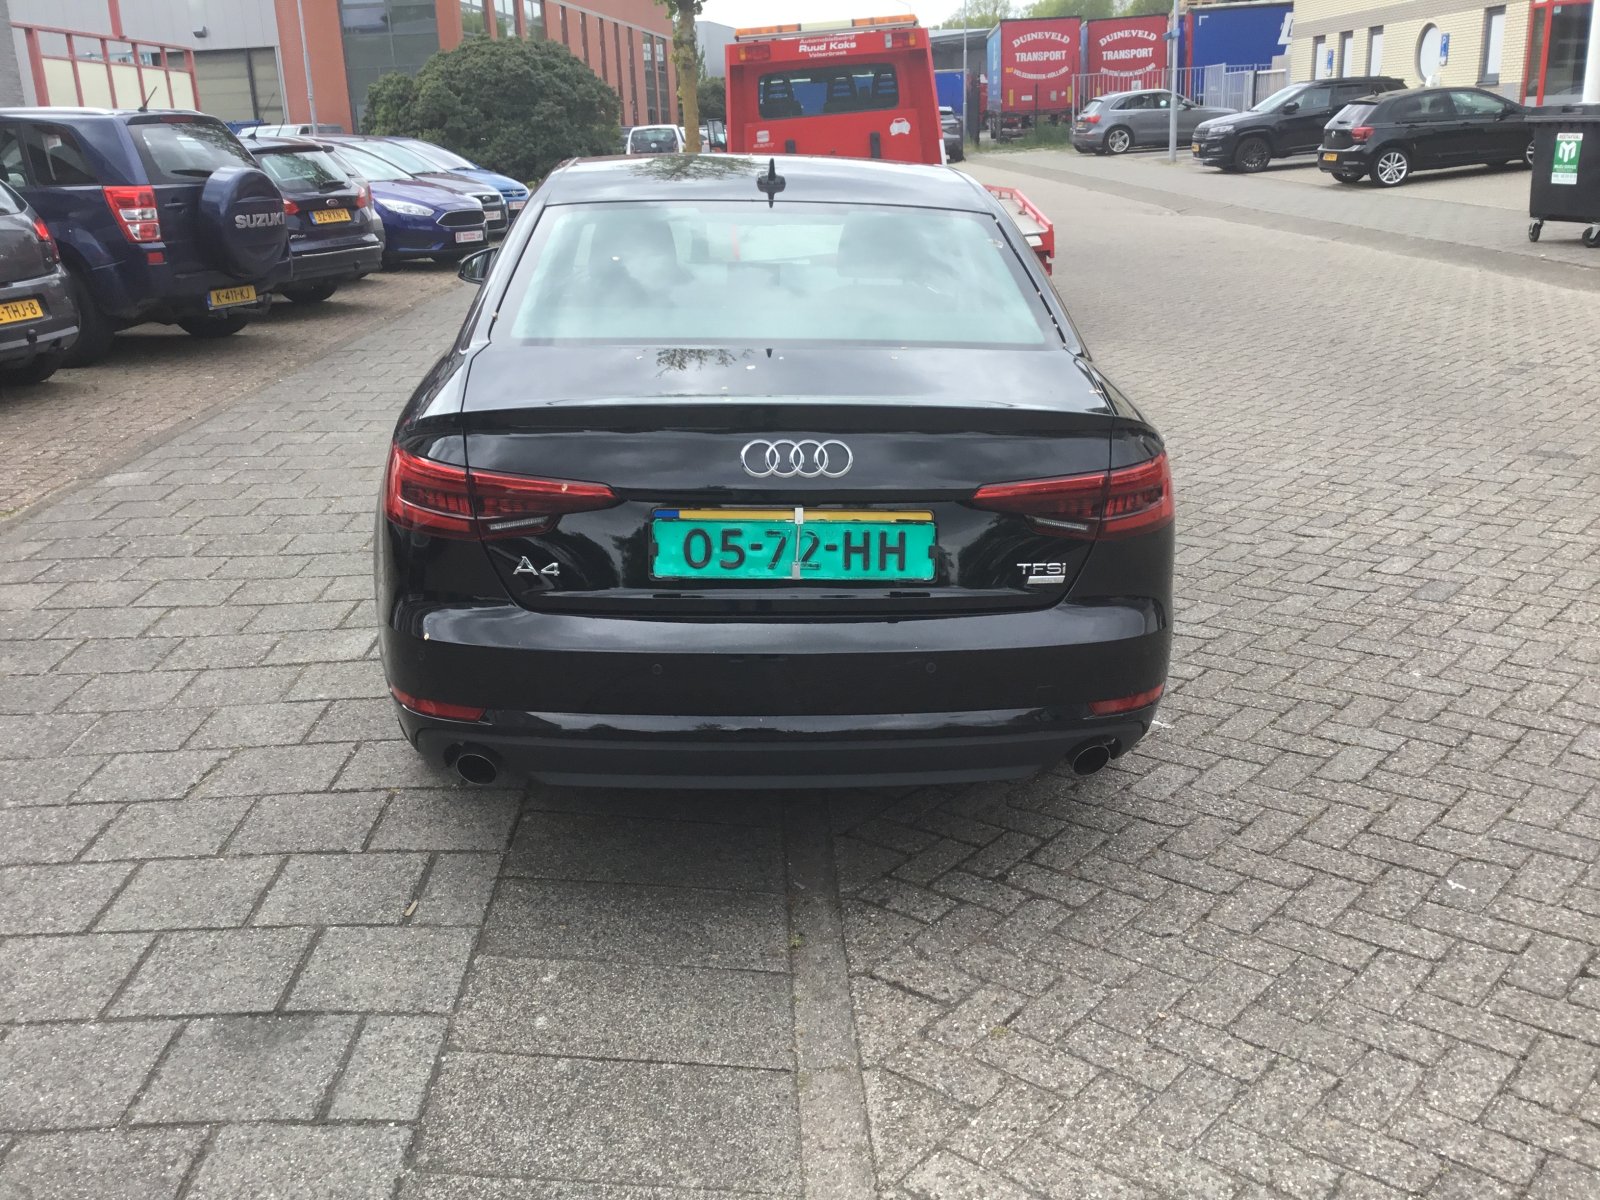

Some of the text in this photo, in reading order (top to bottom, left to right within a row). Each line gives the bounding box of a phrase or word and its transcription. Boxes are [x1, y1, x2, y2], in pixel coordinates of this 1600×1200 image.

[1012, 31, 1070, 48] DUINEVELD
[1098, 29, 1158, 47] DUINEVELD
[798, 43, 827, 53] Ruud
[1015, 50, 1067, 63] TRANSPORT
[1101, 47, 1154, 61] TRANSPORT
[234, 212, 286, 229] SUZUKI
[215, 288, 251, 304] K-411-KJ
[0, 302, 38, 321] -THJ-8
[683, 527, 907, 571] 05-72-HH
[512, 555, 560, 577] A4
